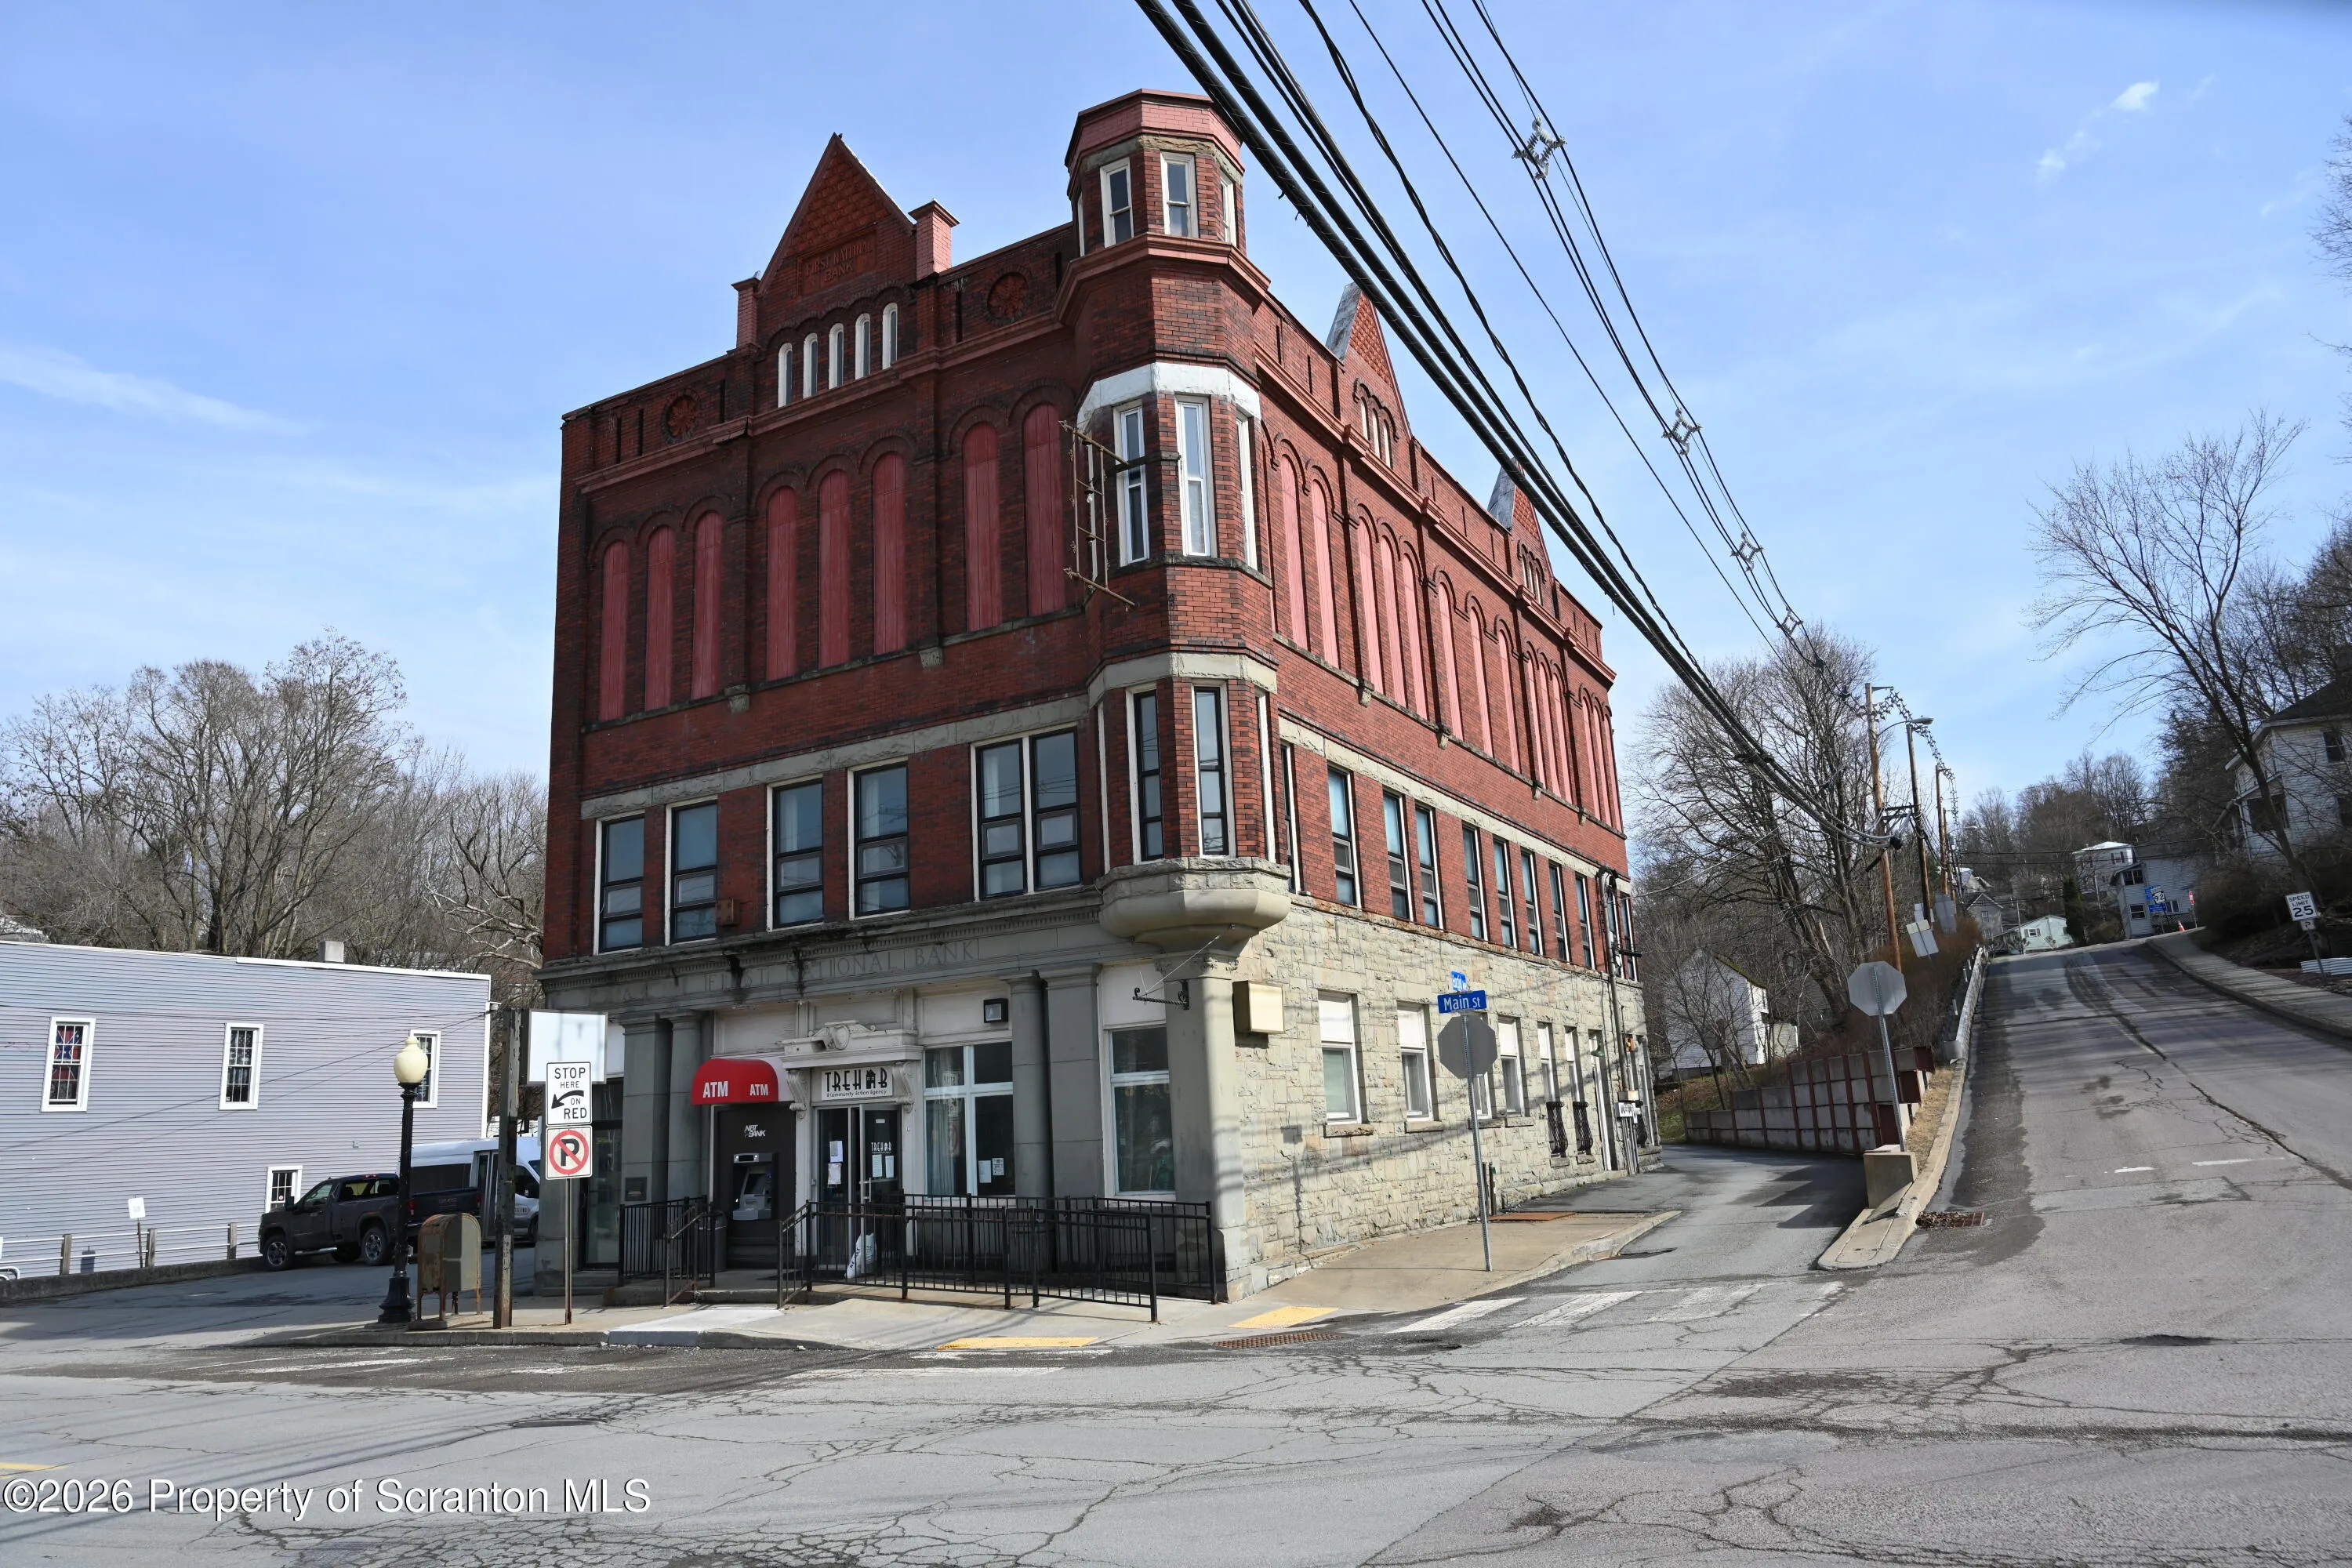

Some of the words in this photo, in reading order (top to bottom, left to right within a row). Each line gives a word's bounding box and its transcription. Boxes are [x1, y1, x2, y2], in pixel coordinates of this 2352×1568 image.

[805, 256, 829, 276] FIRST
[833, 240, 874, 264] NATIONAL
[824, 260, 854, 282] BANK
[2292, 906, 2313, 917] 25
[915, 940, 975, 966] BANK
[1443, 995, 1469, 1011] Main
[1472, 996, 1481, 1008] St
[554, 1067, 586, 1079] STOP
[702, 1081, 728, 1098] ATM
[750, 1083, 768, 1096] ATM
[564, 1107, 587, 1120] RED
